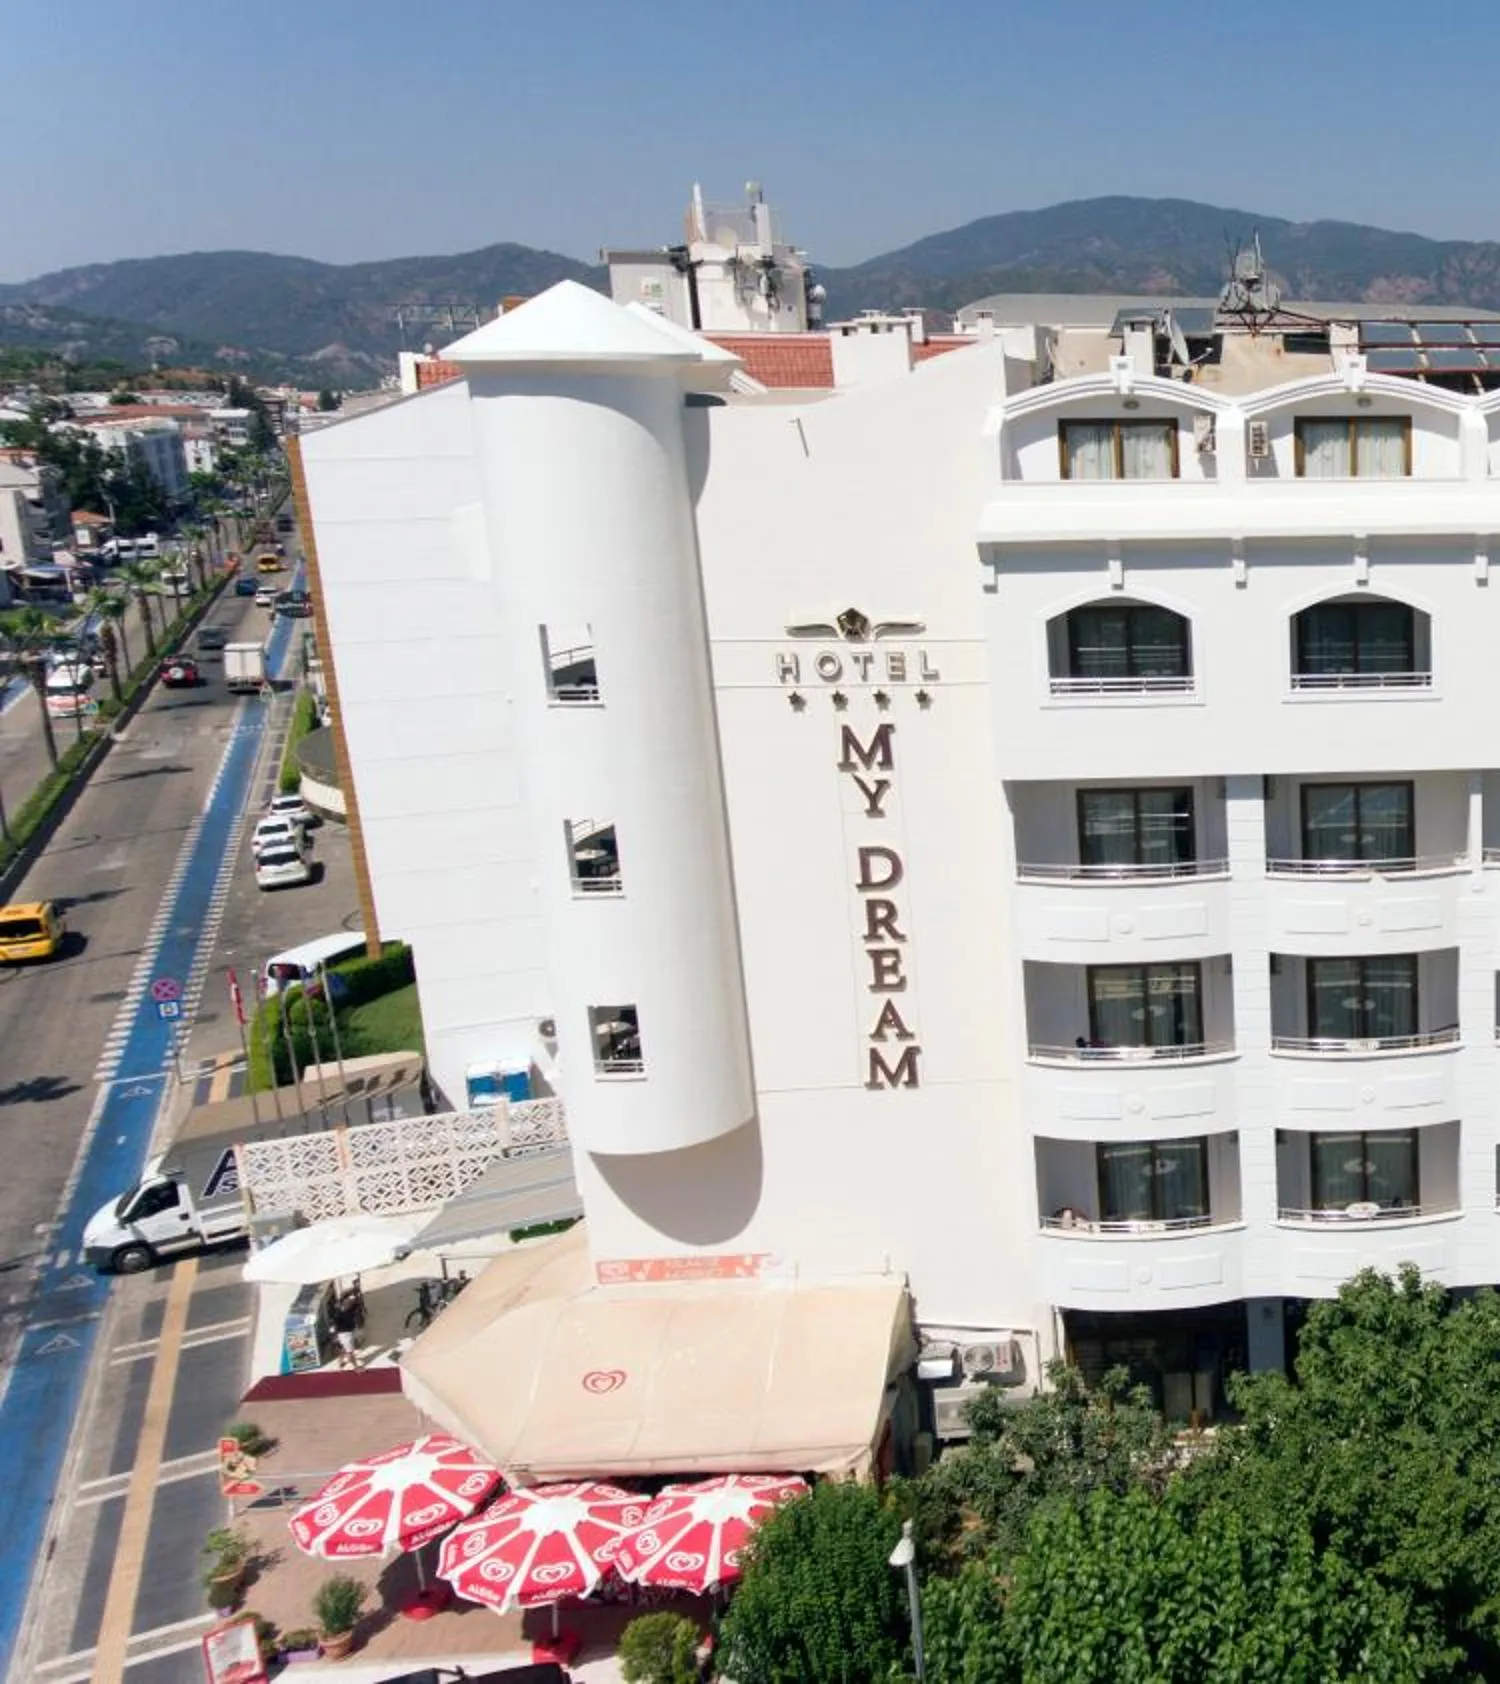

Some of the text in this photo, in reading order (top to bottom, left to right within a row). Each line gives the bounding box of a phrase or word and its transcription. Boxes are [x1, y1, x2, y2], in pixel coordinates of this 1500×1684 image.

[776, 650, 940, 683] HOTEL
[837, 723, 921, 1090] MY DREAM
